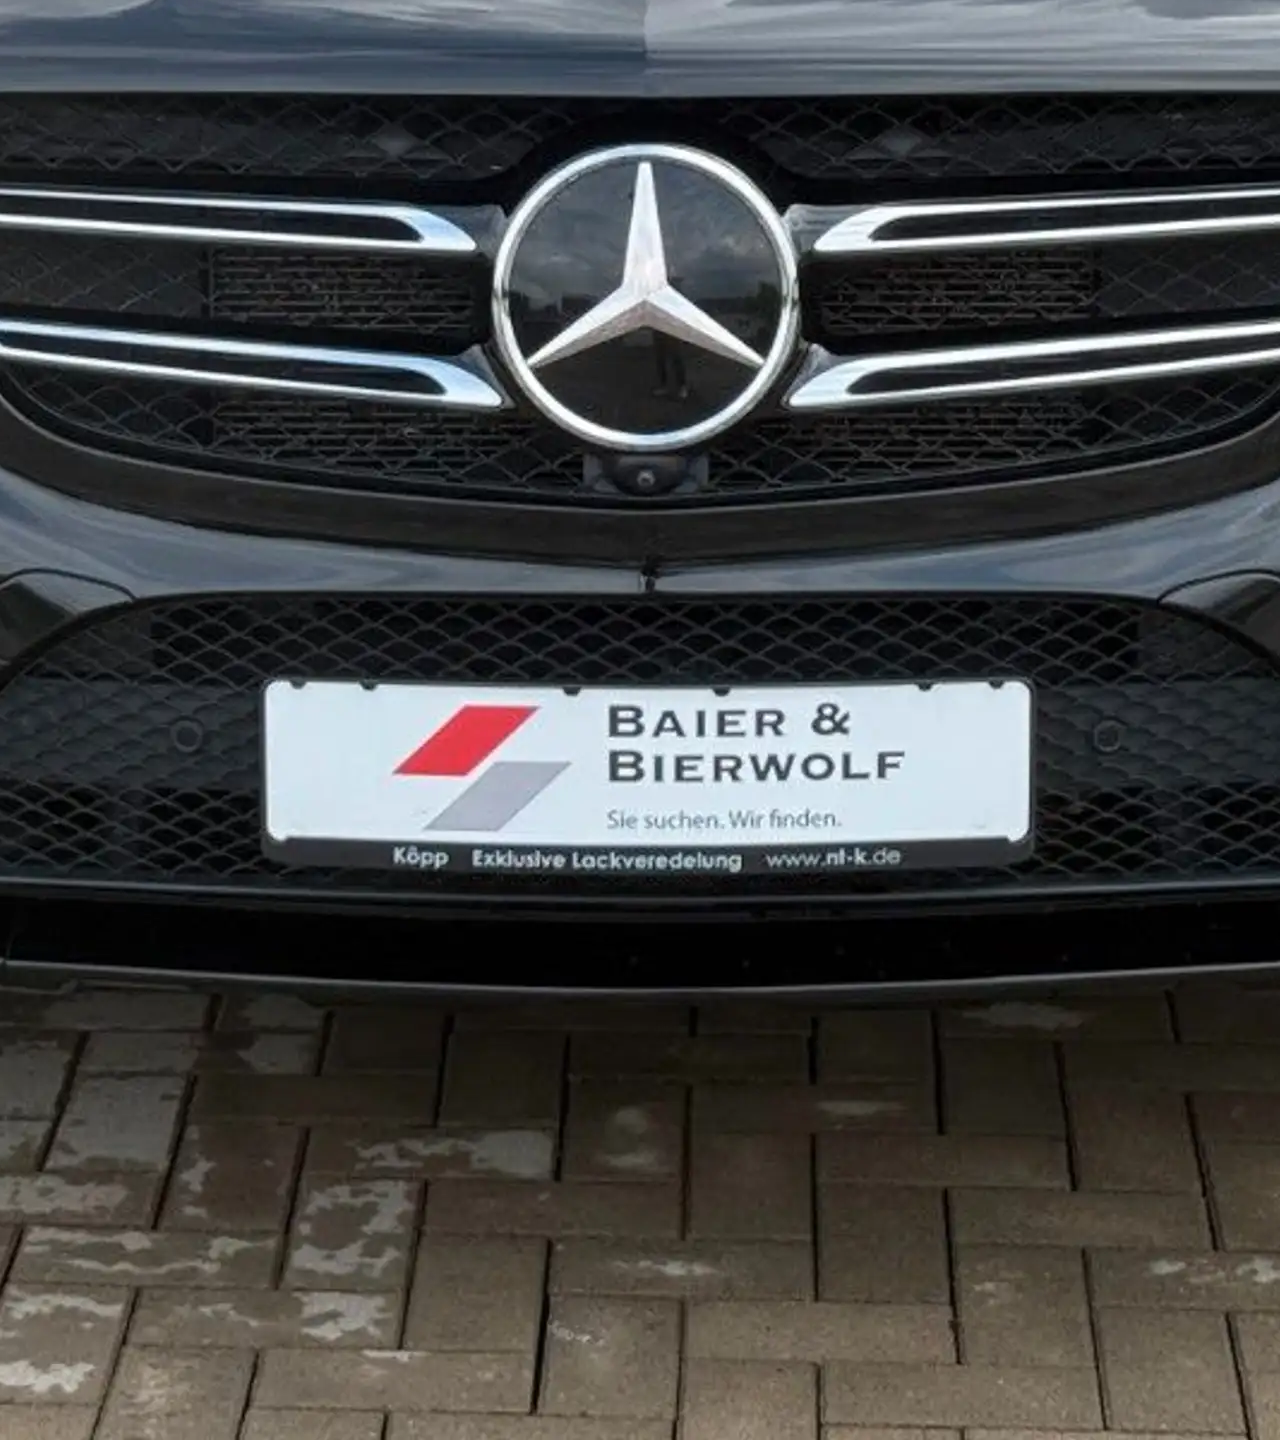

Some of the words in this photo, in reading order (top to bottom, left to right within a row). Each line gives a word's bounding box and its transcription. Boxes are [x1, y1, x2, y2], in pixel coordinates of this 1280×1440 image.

[607, 704, 787, 739] BAIER
[810, 702, 851, 736] &
[607, 749, 906, 783] BIERWOLF
[606, 809, 638, 830] Sie
[643, 809, 726, 830] suchen.
[728, 809, 763, 829] Wir
[768, 807, 843, 829] finden.
[392, 845, 450, 870] Köpp
[471, 848, 567, 870] Exklusive
[572, 851, 744, 873] Lackveredelung
